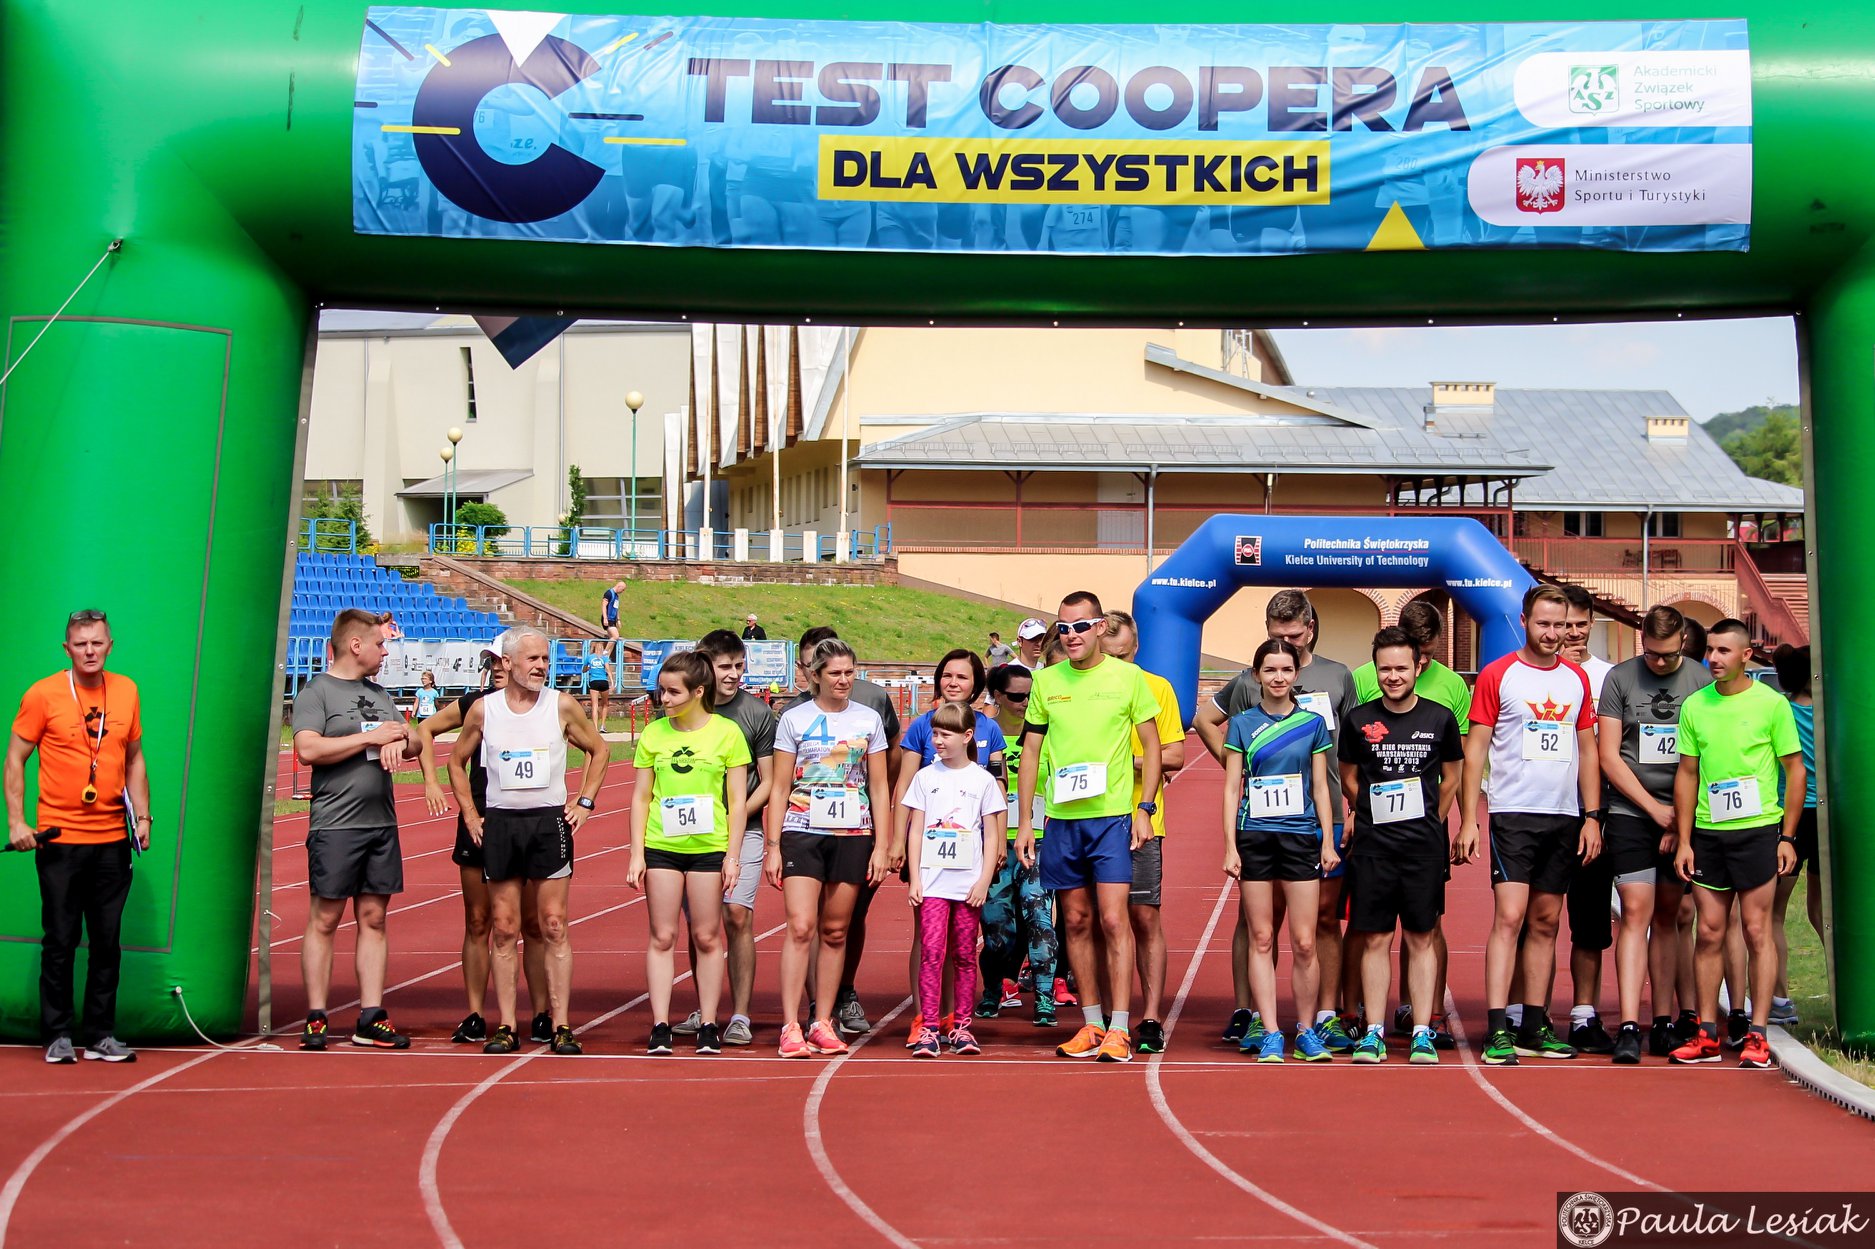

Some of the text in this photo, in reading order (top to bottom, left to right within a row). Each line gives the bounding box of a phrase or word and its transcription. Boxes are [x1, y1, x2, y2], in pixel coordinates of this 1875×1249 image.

[1633, 65, 1717, 77] Akademicki
[686, 57, 1472, 132] TEST COOPERA
[1634, 81, 1694, 96] Związek
[1634, 98, 1705, 113] Sportowy
[833, 149, 1319, 193] DLA WSZYSTKICH
[1574, 169, 1672, 181] Ministerstwo
[1574, 189, 1623, 204] Sportu
[1638, 188, 1707, 204] Turystyki
[1072, 211, 1094, 225] 274
[1303, 536, 1429, 551] Politechnika Świętokrzyska
[1285, 554, 1429, 567] Kielce University of Technology
[1151, 576, 1217, 589] www.tu.kielce.pl
[1445, 577, 1513, 589] www.tu.kielce.pl
[1540, 733, 1559, 752] 52
[1657, 737, 1676, 755] 42
[514, 761, 534, 779] 49
[1070, 774, 1088, 792] 75
[1263, 788, 1289, 807] 111
[1386, 792, 1405, 813] 77
[1722, 790, 1743, 811] 76
[678, 807, 697, 826] 54
[827, 800, 845, 819] 41
[937, 841, 957, 860] 44
